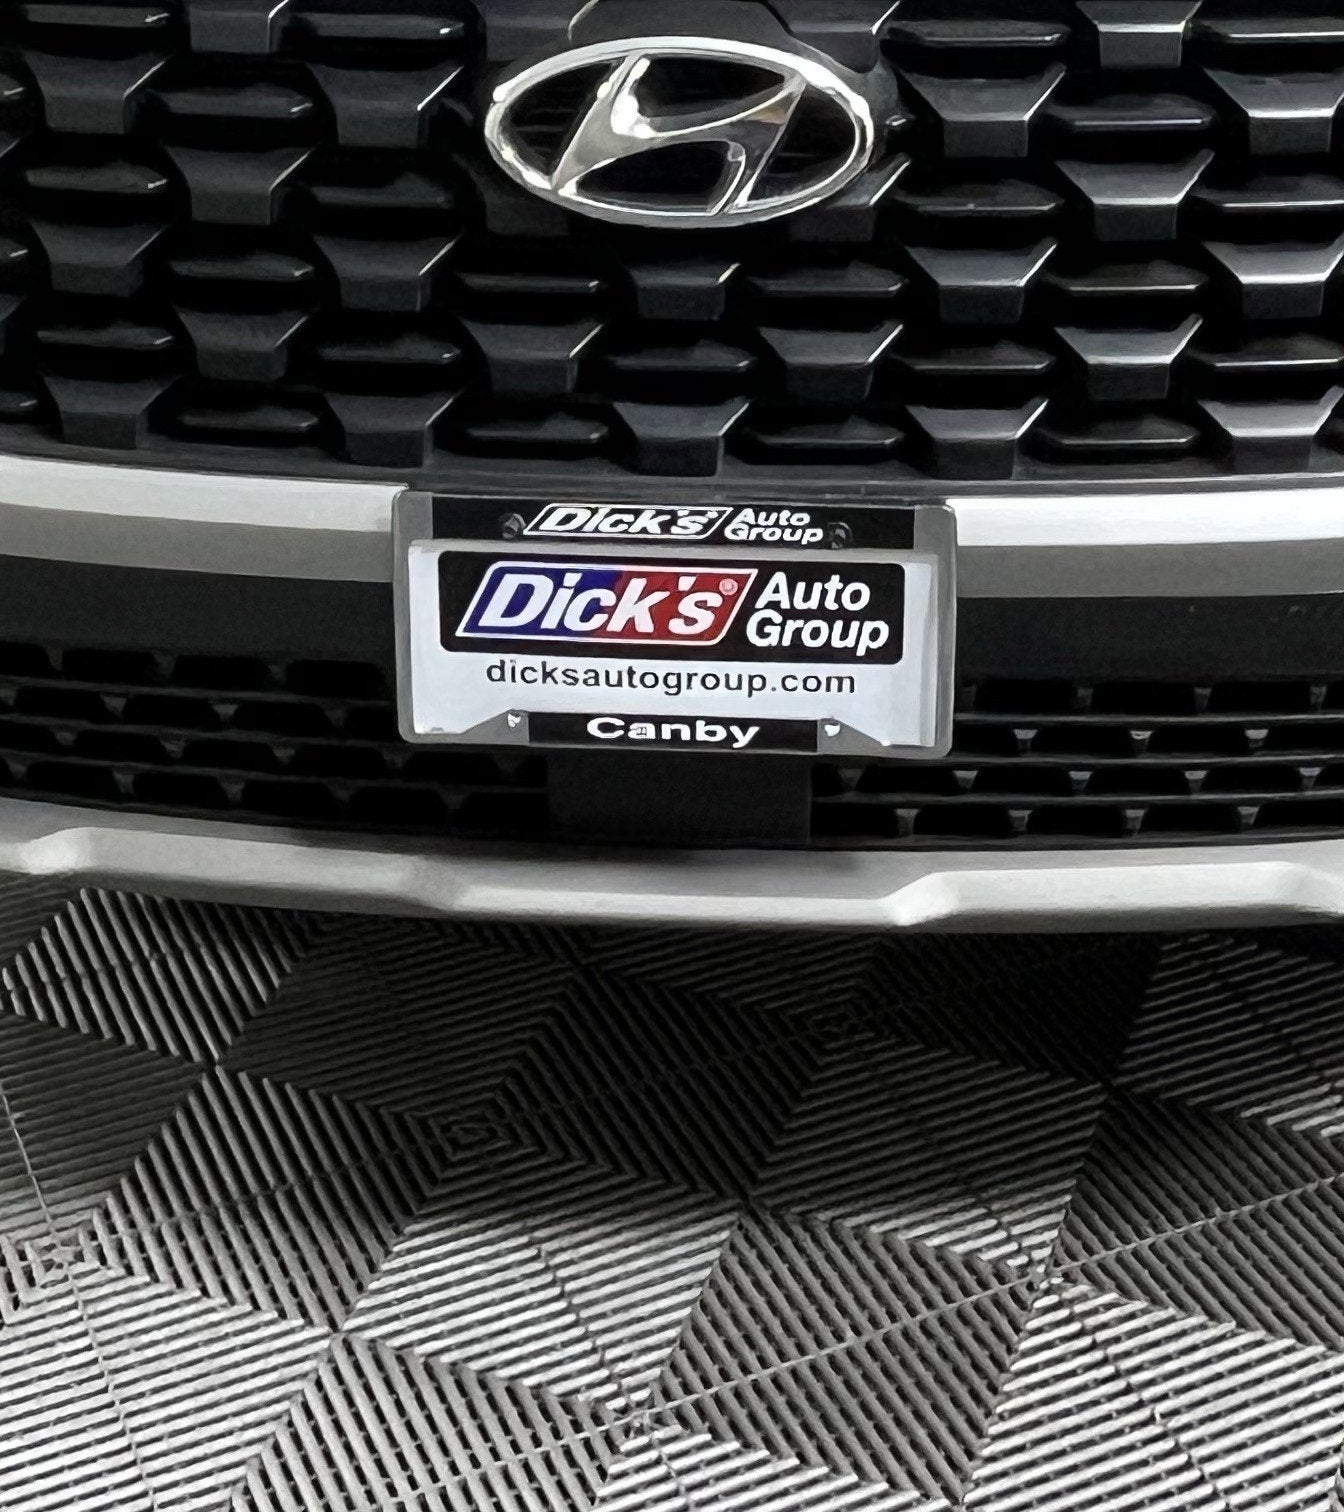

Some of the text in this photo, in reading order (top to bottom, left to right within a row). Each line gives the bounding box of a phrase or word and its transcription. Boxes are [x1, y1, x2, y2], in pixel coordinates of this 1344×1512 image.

[538, 507, 709, 535] Dick's
[724, 523, 824, 544] Group
[733, 508, 811, 526] Auto
[478, 572, 723, 635] Dick's
[756, 572, 871, 611] Auto
[746, 611, 889, 657] Group
[486, 660, 856, 697] dicksautogroup.com
[587, 717, 760, 748] Canby
